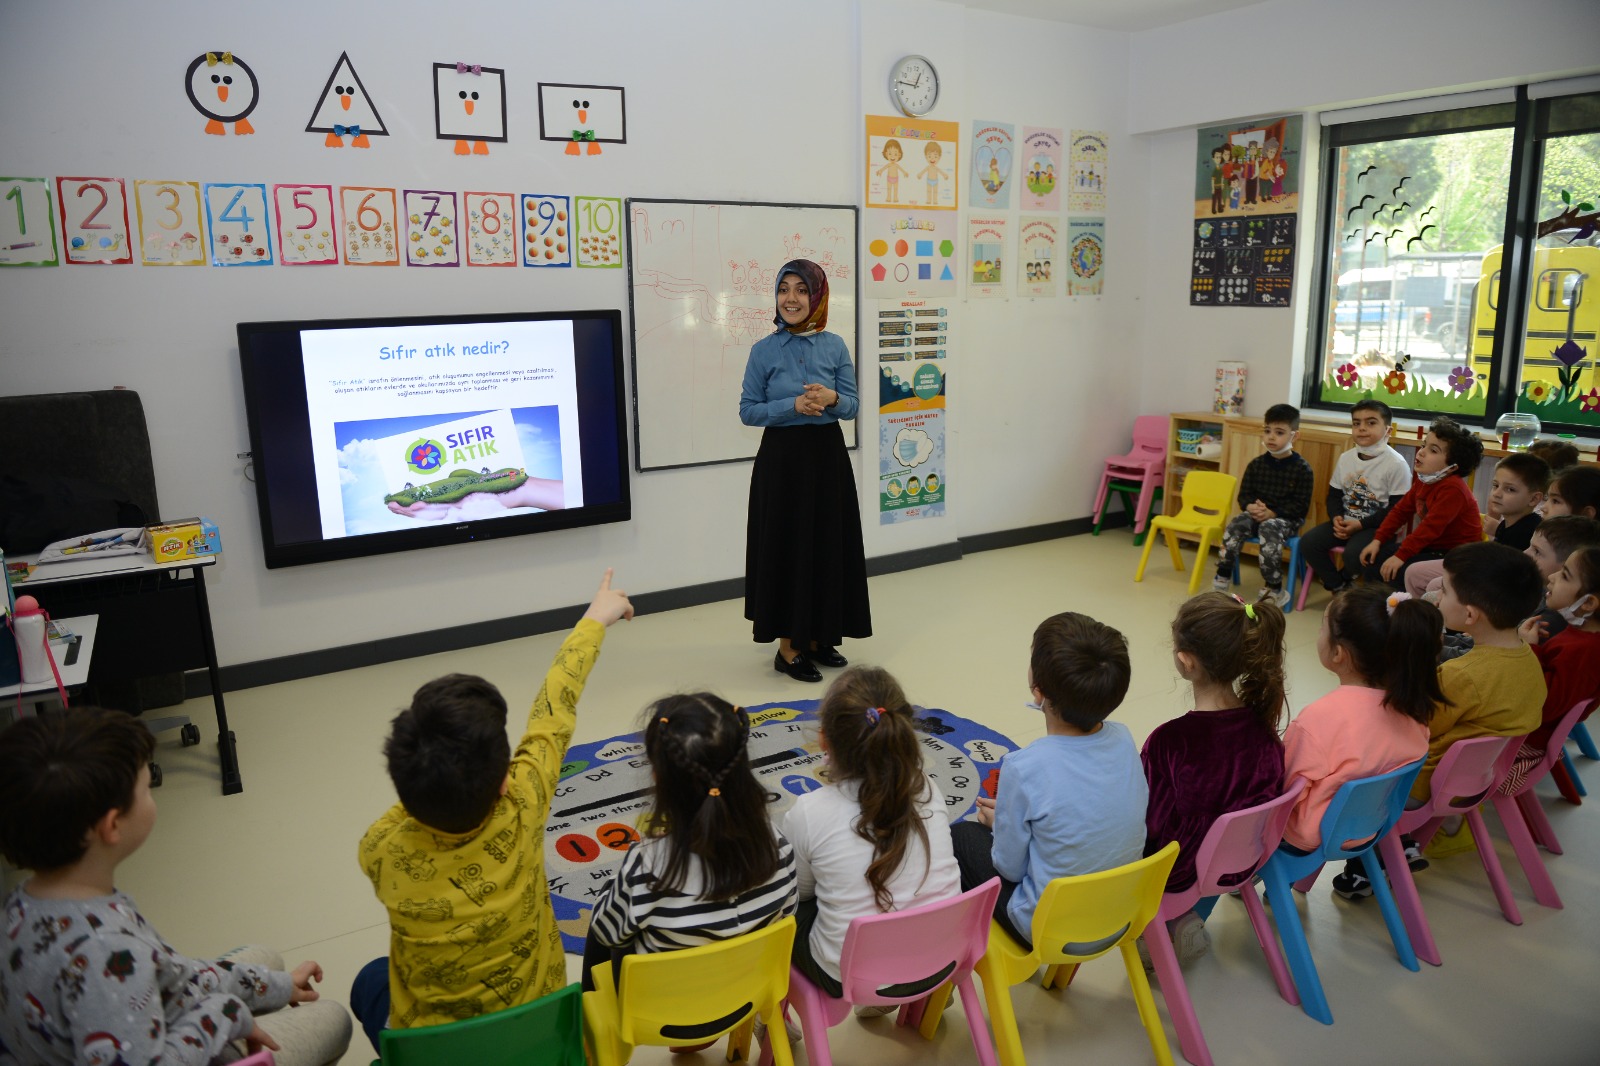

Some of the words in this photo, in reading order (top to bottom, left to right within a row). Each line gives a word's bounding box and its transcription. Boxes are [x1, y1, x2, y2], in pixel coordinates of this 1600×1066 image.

[6, 185, 26, 235] 1
[77, 183, 111, 229] 2
[156, 186, 183, 230] 3
[219, 189, 254, 232] 4
[293, 190, 317, 229] 5
[357, 192, 382, 231] 6
[421, 196, 440, 231] 7
[480, 198, 500, 234] 8
[538, 201, 555, 235] 9
[582, 202, 614, 233] 10
[1222, 238, 1228, 247] 2
[1246, 237, 1253, 247] 3
[1199, 265, 1204, 274] 5
[1232, 265, 1238, 274] 6
[1228, 293, 1235, 303] 9
[1262, 294, 1271, 303] 10
[379, 344, 417, 360] Sıfır
[424, 342, 456, 358] atık
[462, 340, 510, 355] nedir?
[446, 426, 495, 448] SIFIR
[454, 440, 499, 464] ATIK
[752, 710, 787, 724] yellow
[785, 724, 801, 733] Ii
[602, 743, 644, 758] white
[922, 737, 945, 751] Mm
[759, 763, 793, 775] seven
[793, 754, 823, 768] eight
[947, 756, 966, 769] Nn
[586, 769, 614, 782] Dd
[951, 775, 970, 789] Oo
[554, 785, 577, 798] Cc
[787, 777, 813, 793] 7
[546, 821, 571, 833] one
[580, 811, 607, 823] two
[603, 828, 636, 848] 2
[569, 840, 588, 857] 1
[590, 868, 613, 880] bir
